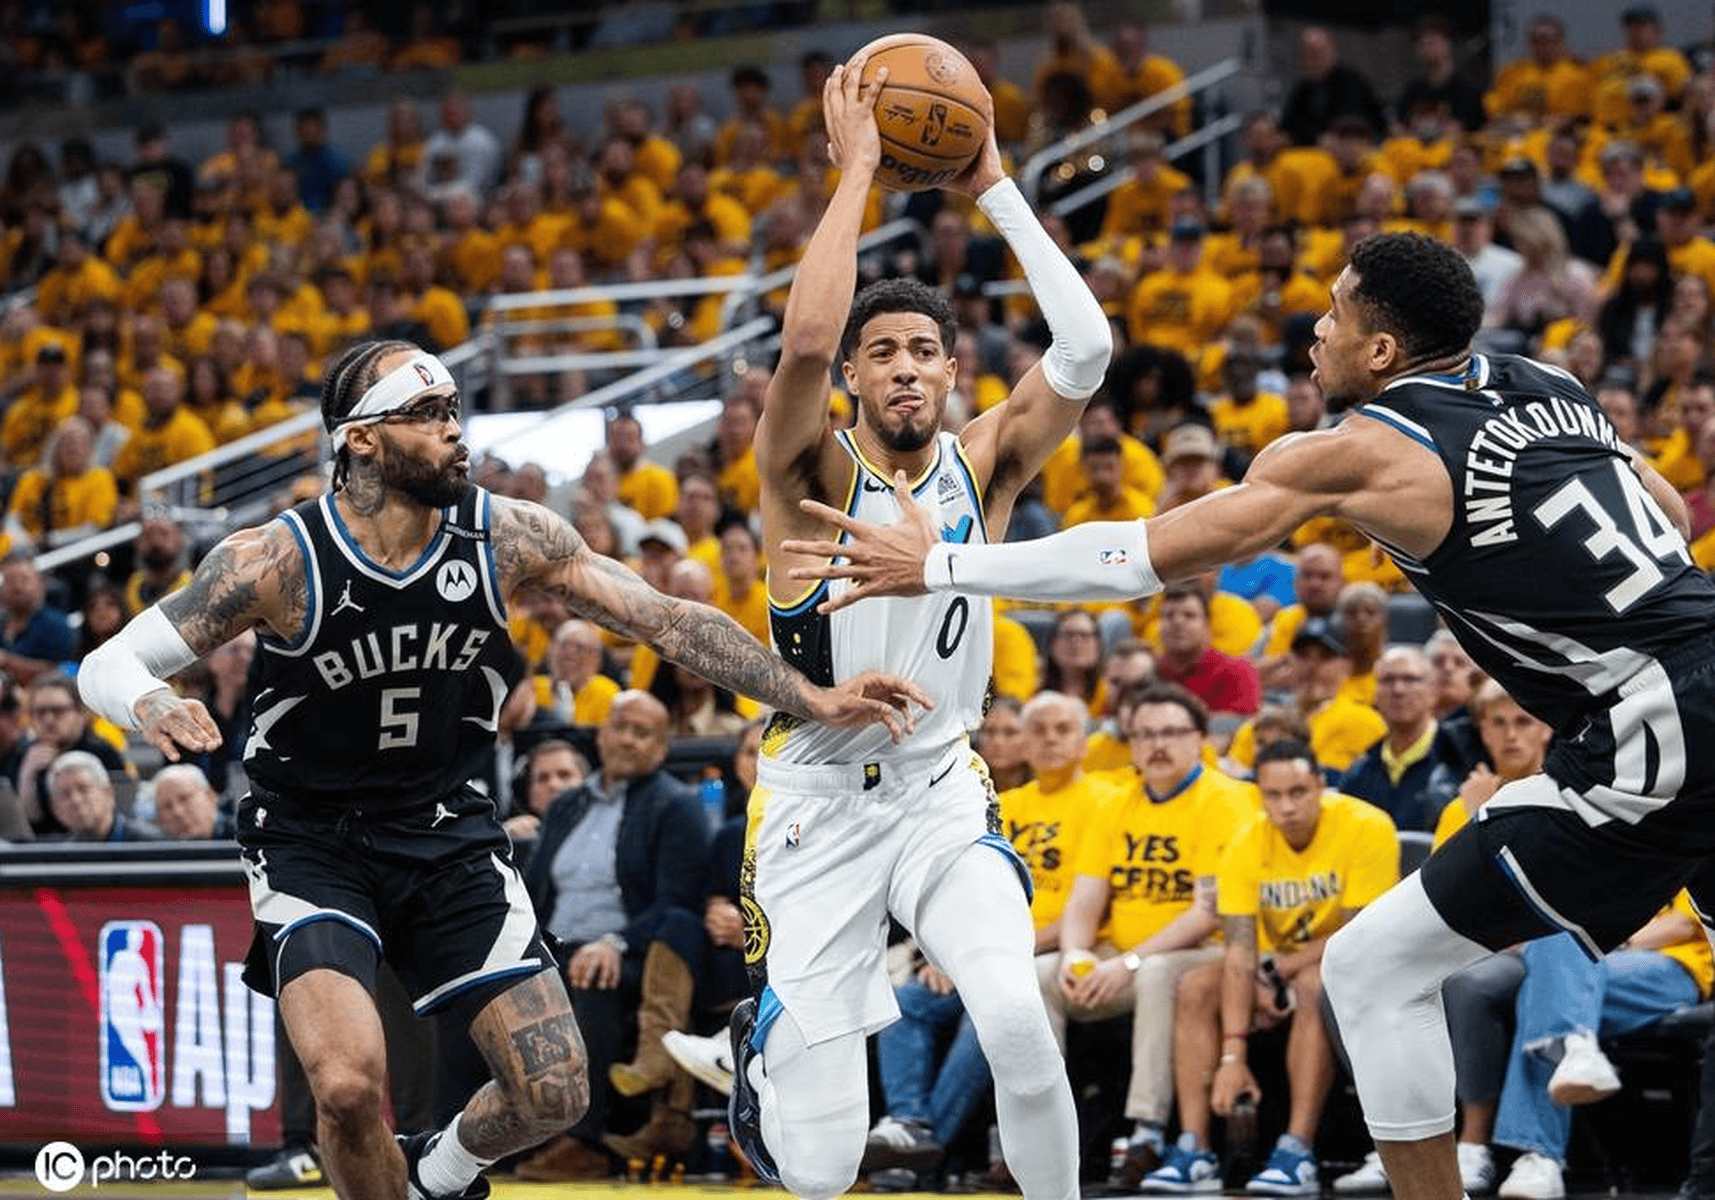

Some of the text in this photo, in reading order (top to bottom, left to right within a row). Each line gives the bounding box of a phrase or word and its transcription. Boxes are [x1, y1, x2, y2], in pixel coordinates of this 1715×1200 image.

[1465, 397, 1620, 547] ANTETOKOUNM
[1533, 456, 1692, 612] 34
[312, 621, 491, 690] BUCKS
[936, 596, 969, 660] 0
[378, 687, 421, 750] 5
[1123, 832, 1180, 863] YES
